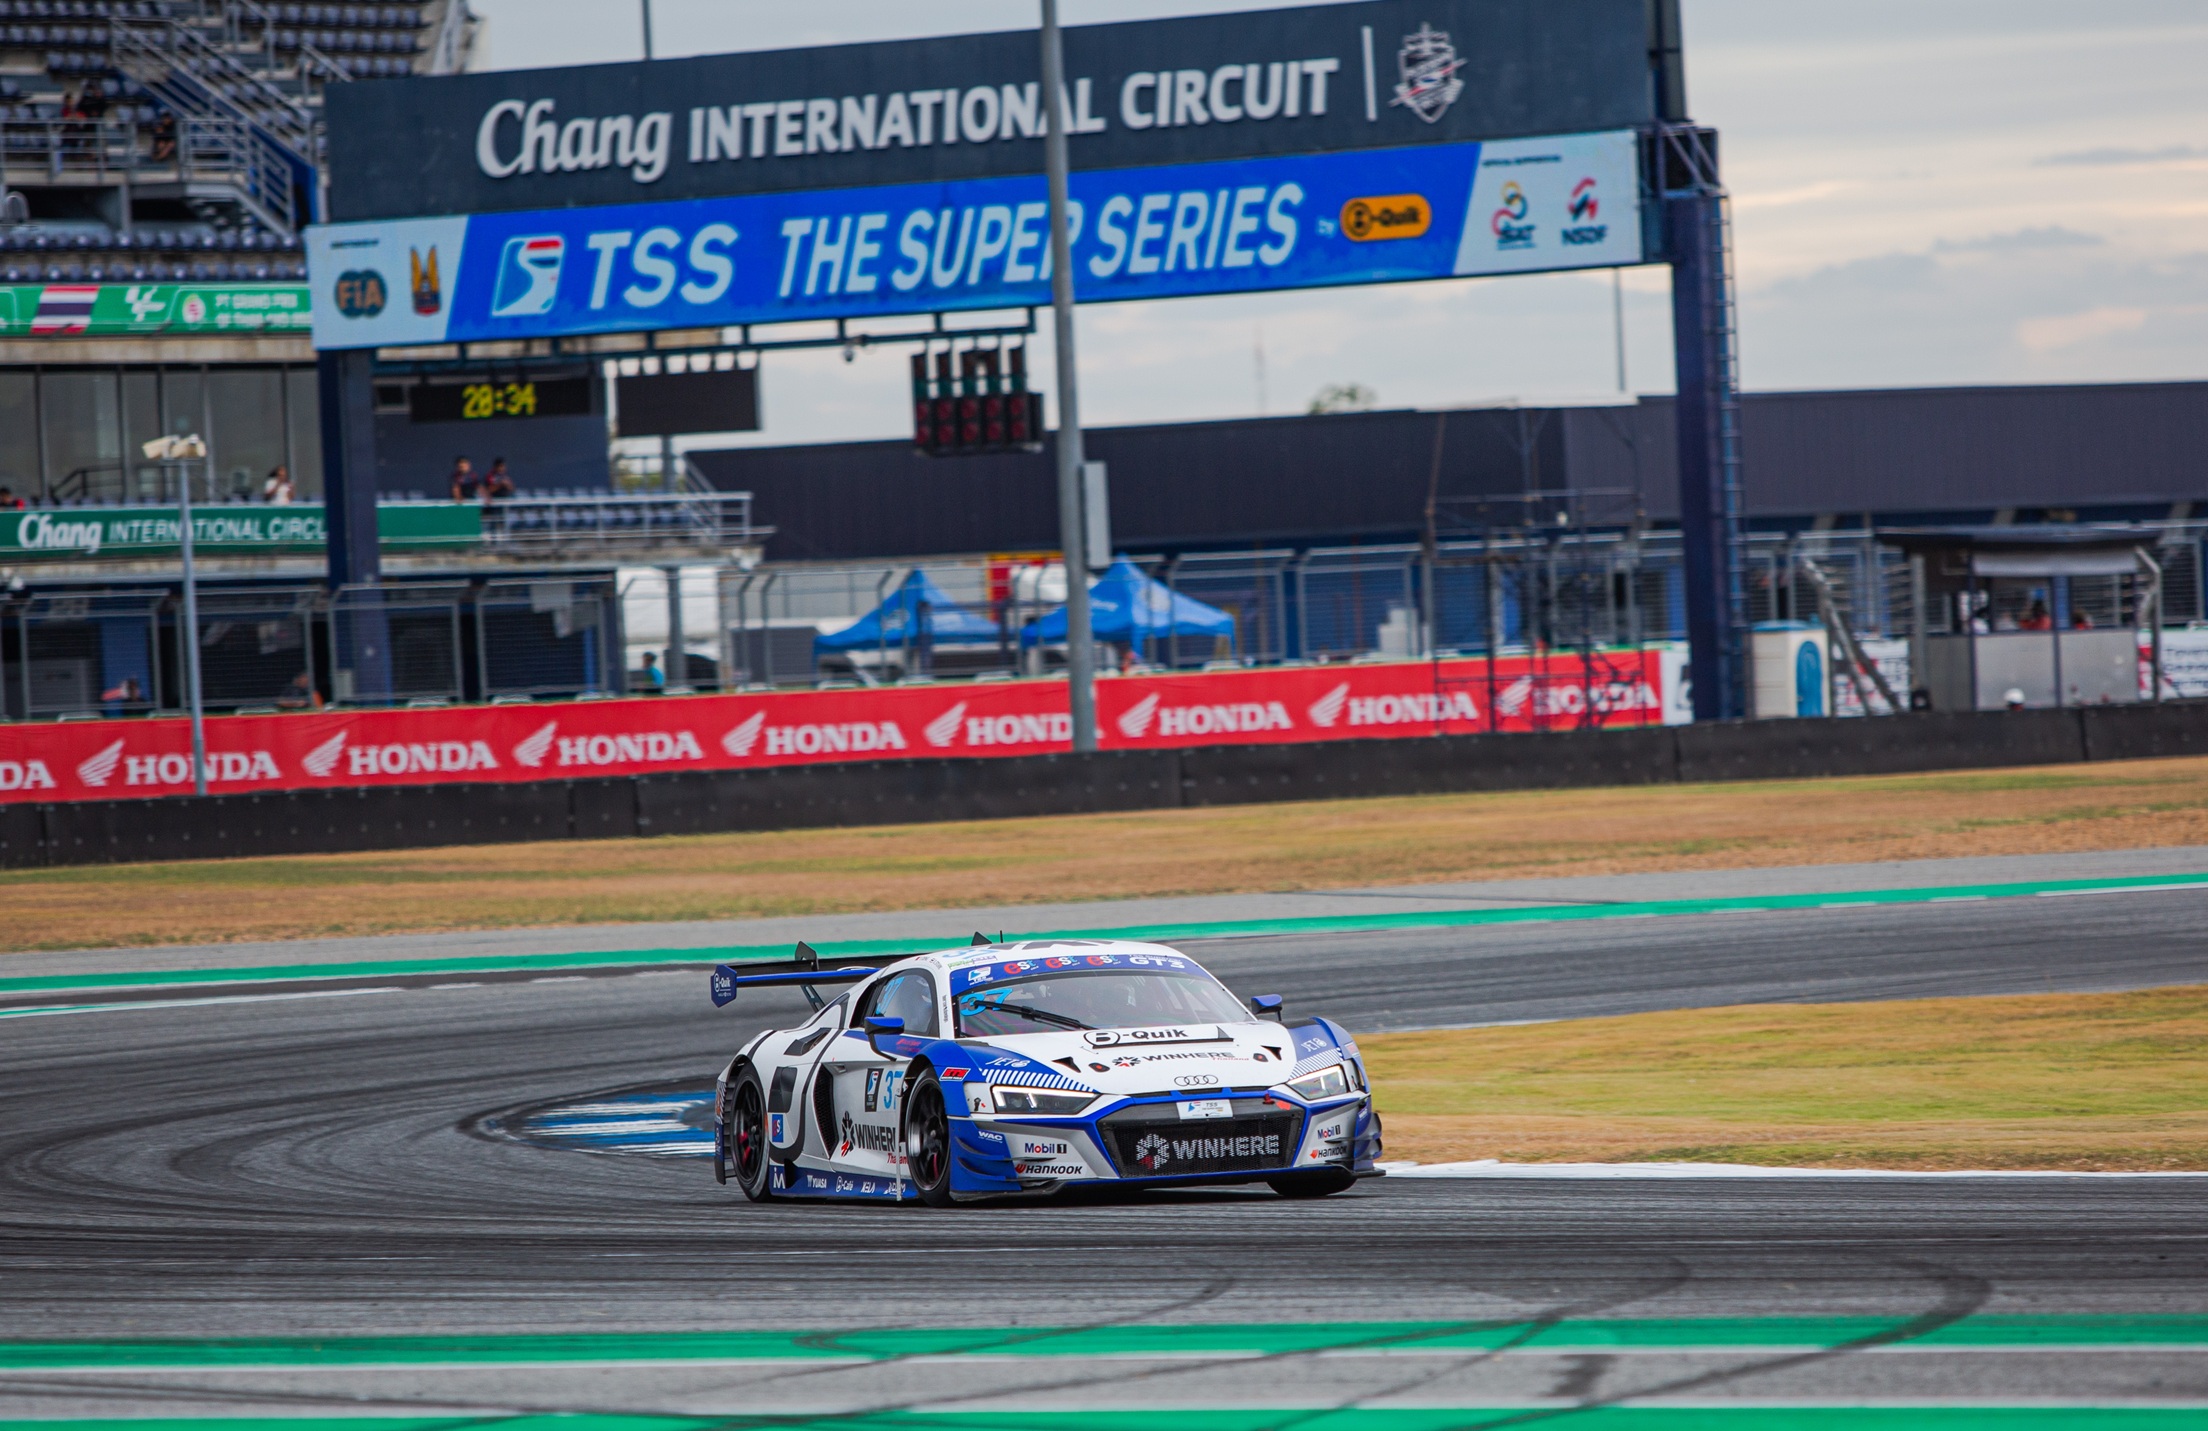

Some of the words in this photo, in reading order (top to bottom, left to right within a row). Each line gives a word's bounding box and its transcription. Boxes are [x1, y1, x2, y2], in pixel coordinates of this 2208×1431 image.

[475, 99, 673, 183] Chang
[1120, 58, 1339, 131] CIRCUIT
[587, 223, 739, 311] TSS
[779, 212, 889, 298] THE
[1088, 182, 1305, 278] SERIES
[17, 513, 103, 553] Chang
[108, 517, 264, 543] INTERNTIONAL
[1159, 702, 1294, 737] HONDA
[1348, 691, 1479, 726] HONDA
[765, 721, 906, 756] HONDA
[965, 712, 1104, 746] HOND
[348, 741, 499, 776] HONDA
[557, 731, 704, 767] HONDA
[1004, 960, 1036, 975] est
[1045, 956, 1078, 969] est
[1086, 954, 1118, 967] est
[1129, 956, 1186, 969] GT3
[960, 988, 1013, 1017] 37
[1142, 1052, 1235, 1061] WINHERE
[1024, 1143, 1055, 1154] Mobil
[1172, 1134, 1280, 1160] WINHERE
[1317, 1127, 1335, 1140] Mobil
